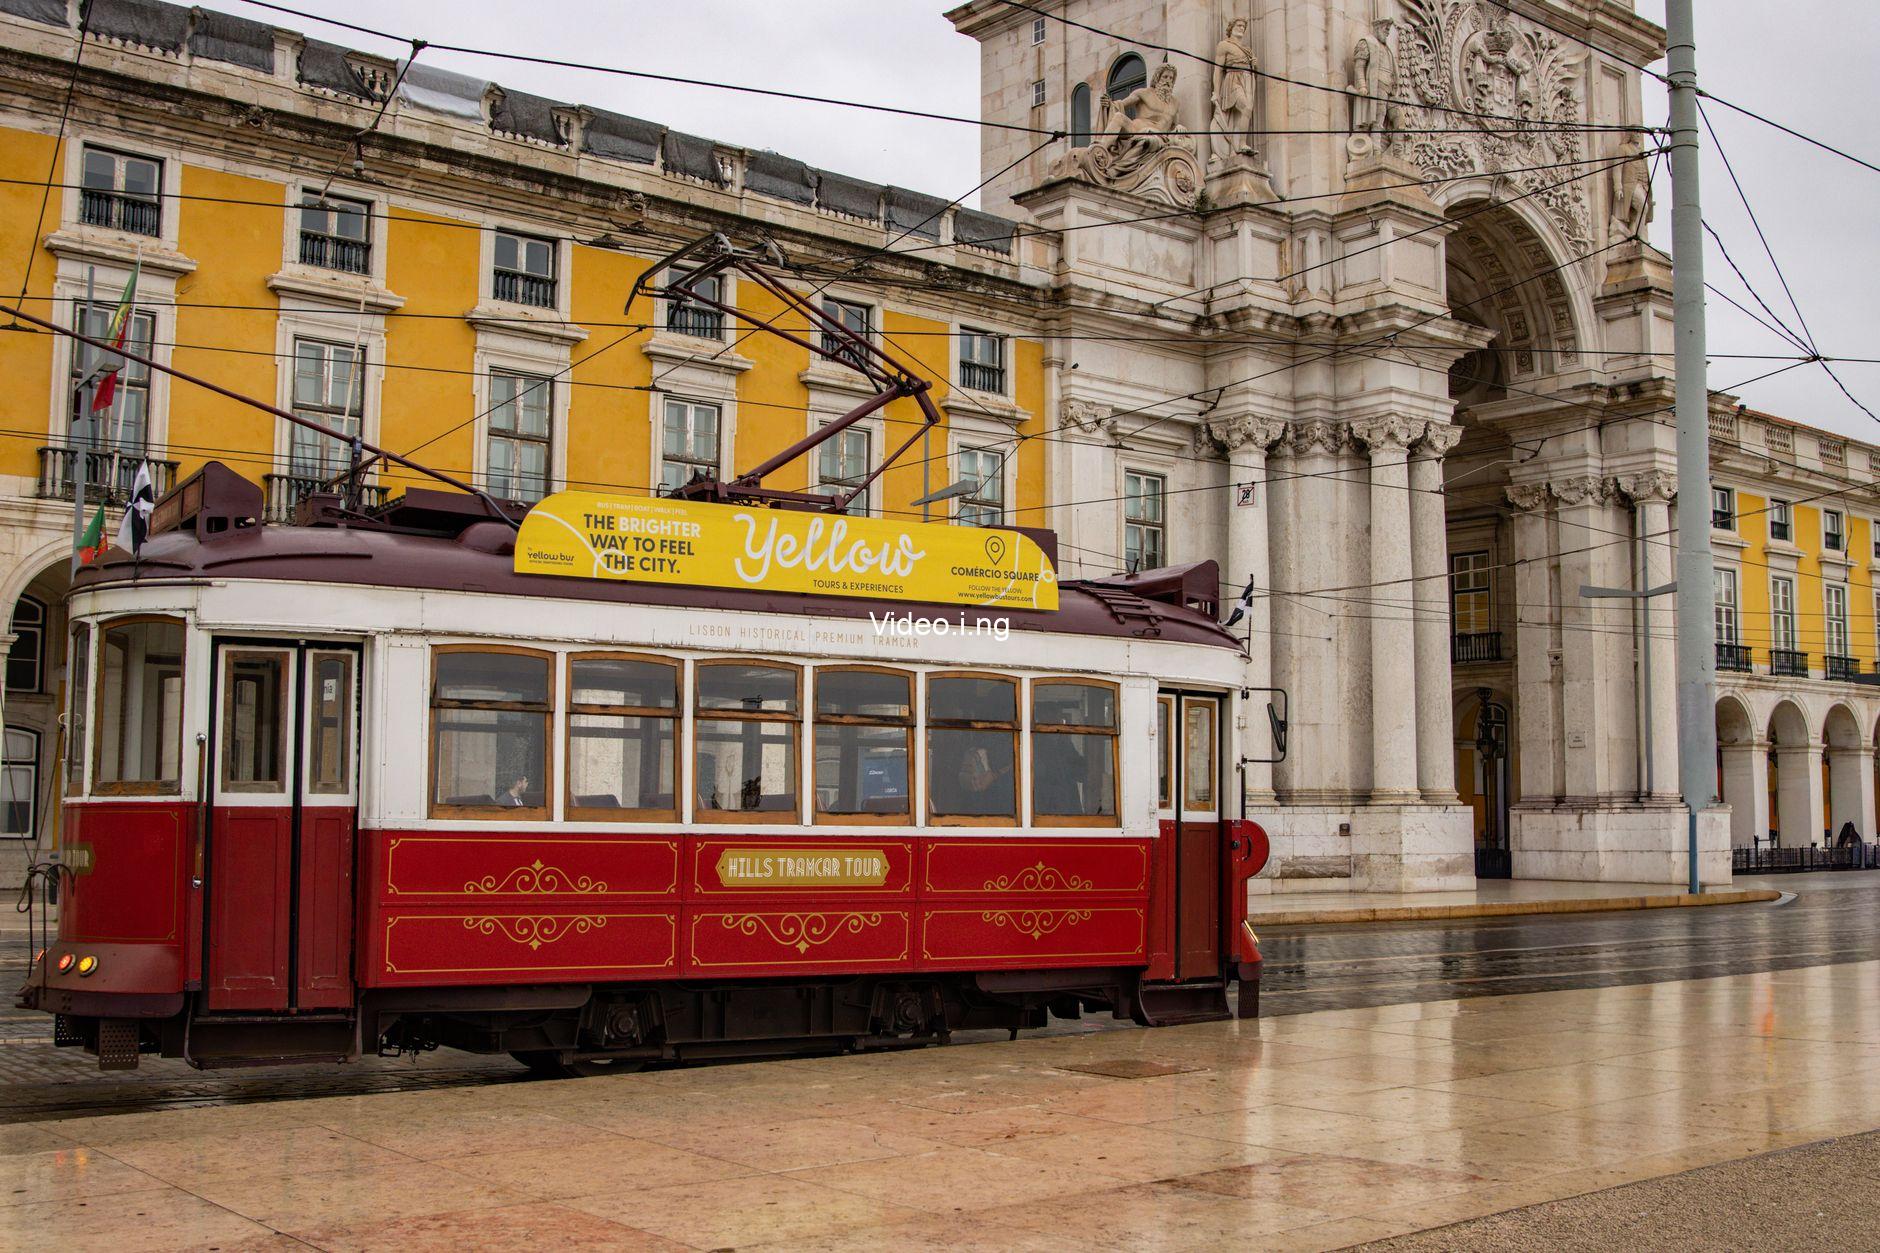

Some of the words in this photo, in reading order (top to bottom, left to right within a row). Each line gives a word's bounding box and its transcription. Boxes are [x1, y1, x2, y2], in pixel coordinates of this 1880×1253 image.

[583, 513, 615, 530] THE
[618, 516, 701, 538] BRIGHTER
[589, 533, 628, 550] WAY
[633, 537, 656, 552] TO
[660, 539, 695, 556] FEEL
[604, 554, 635, 570] THE
[639, 557, 681, 574] CITY.
[951, 565, 1001, 579] COMÉRCIO
[1003, 570, 1039, 582] SQUARE
[813, 579, 840, 589] TOURS
[842, 581, 848, 590] &
[850, 582, 904, 594] EXPERIENCES
[968, 584, 991, 592] FOLLOW
[689, 623, 731, 637] LISBON
[740, 626, 805, 642] HISTORICAL
[815, 631, 864, 644] PREMIUM
[872, 634, 919, 649] TRAMCAR
[728, 857, 773, 878] HILLS
[777, 857, 840, 878] TRAMCAR
[844, 857, 881, 877] TOUR
